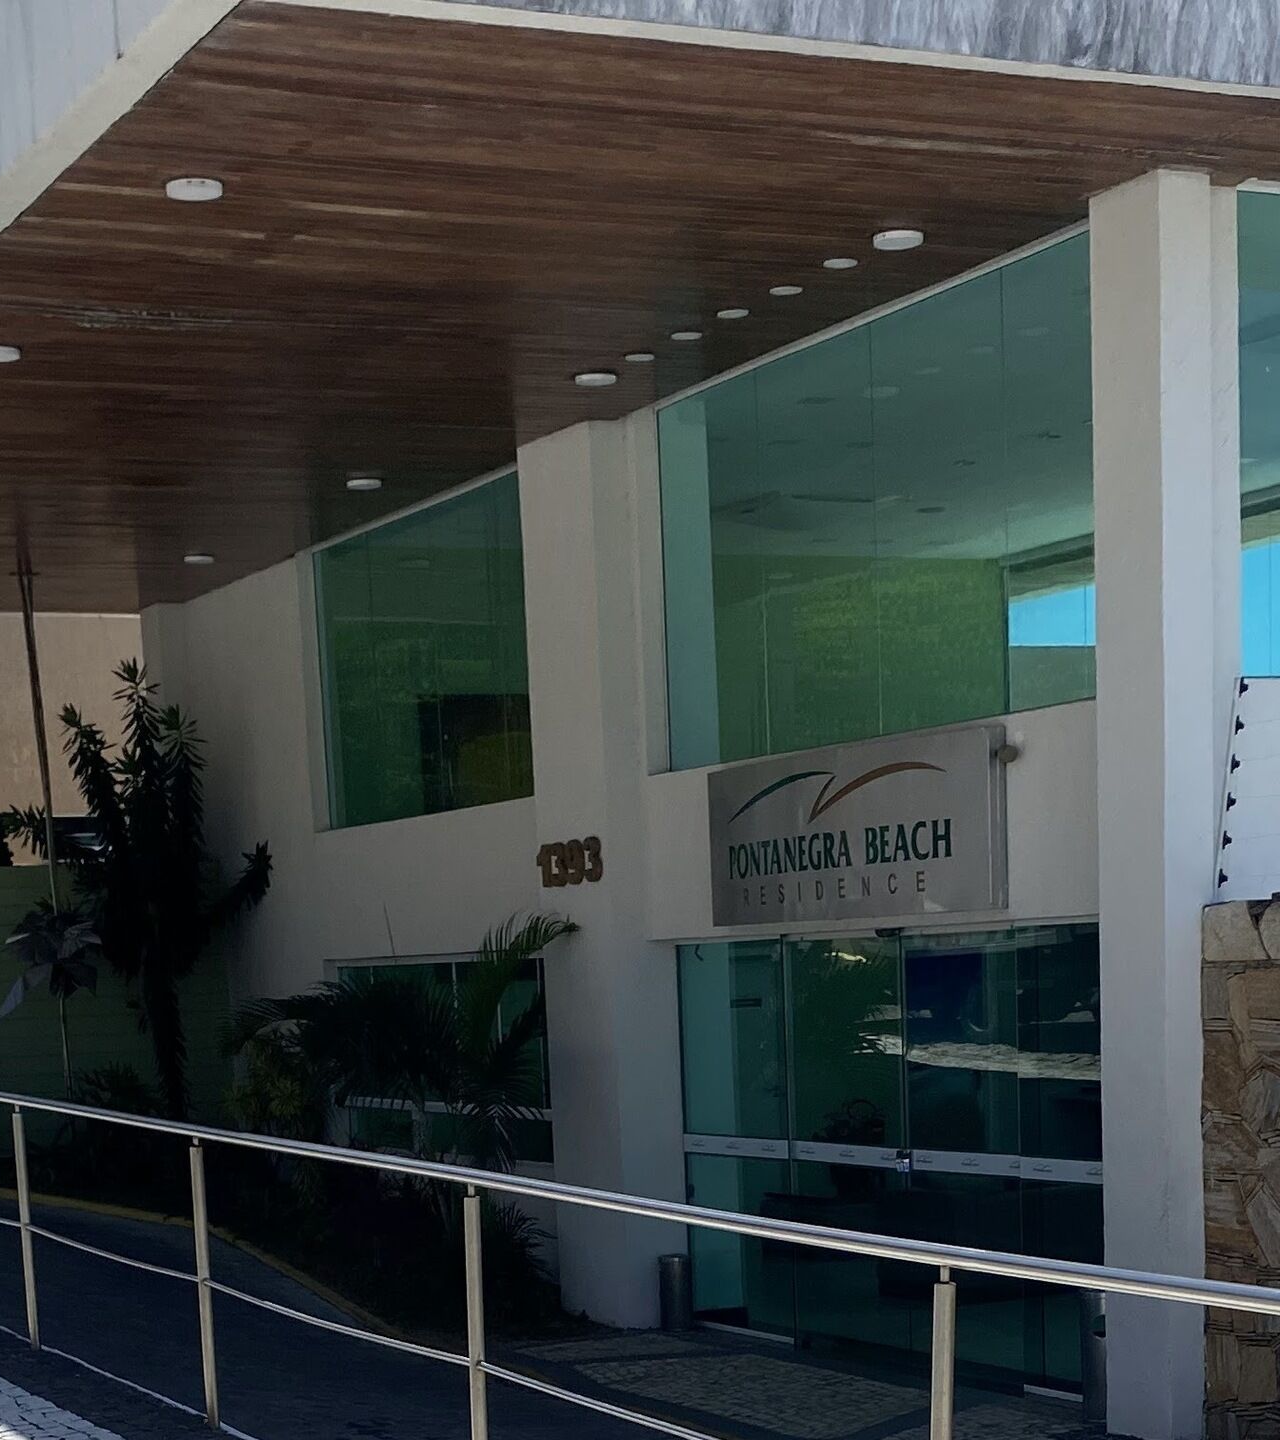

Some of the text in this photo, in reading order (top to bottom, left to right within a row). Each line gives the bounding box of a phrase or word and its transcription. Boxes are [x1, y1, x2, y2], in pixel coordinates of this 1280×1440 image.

[536, 836, 603, 888] 1393
[728, 818, 952, 880] PONTANEGRA BEACH
[743, 870, 926, 907] RESIDENCE
